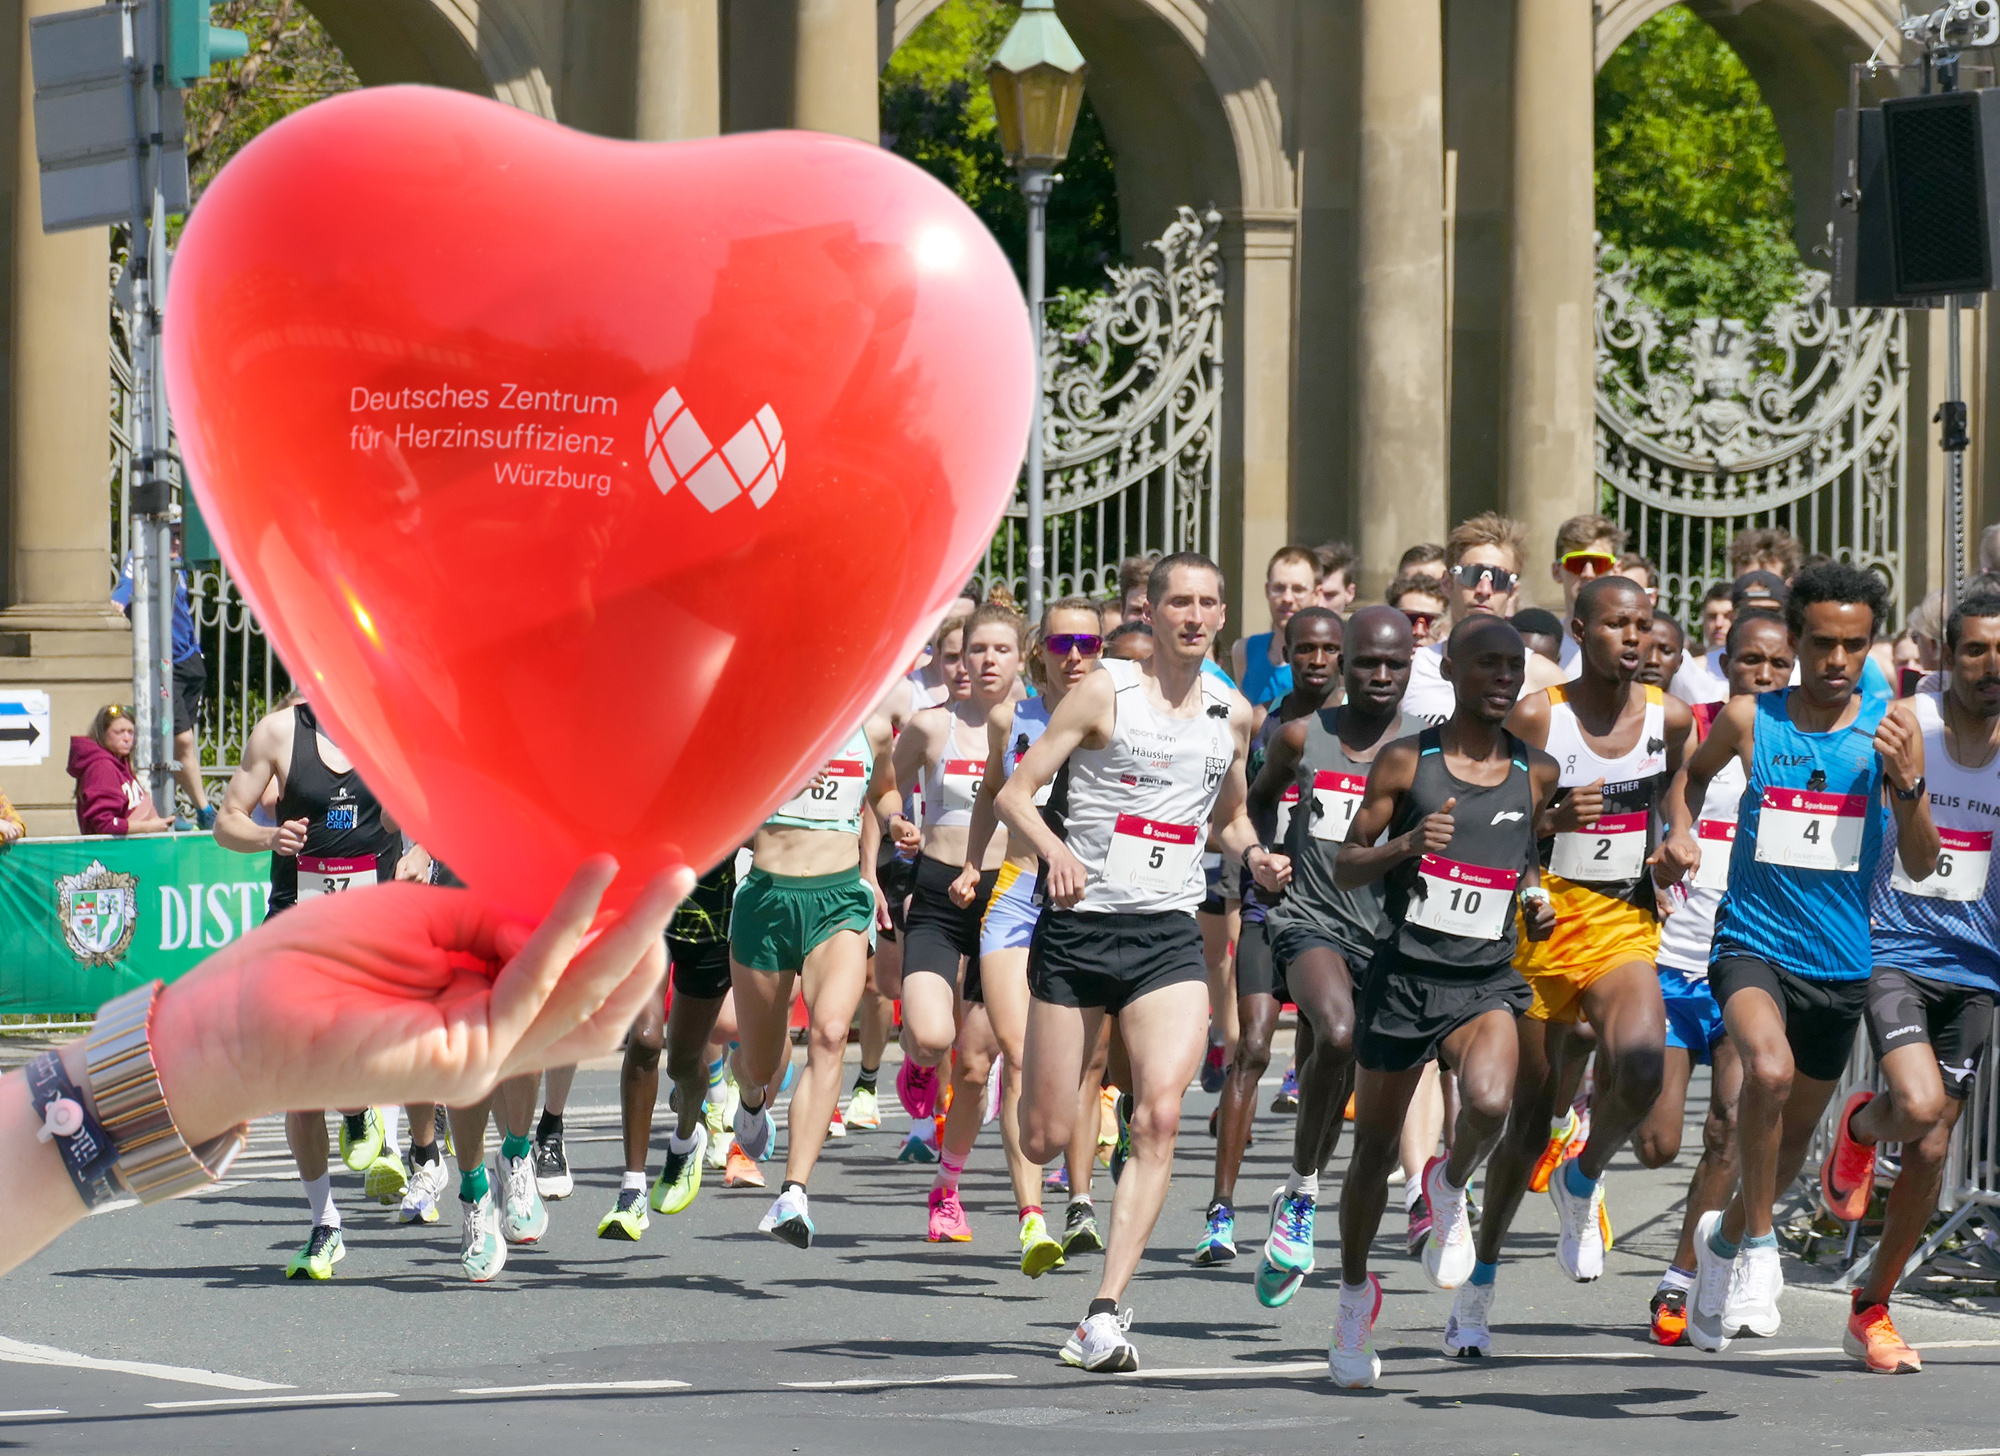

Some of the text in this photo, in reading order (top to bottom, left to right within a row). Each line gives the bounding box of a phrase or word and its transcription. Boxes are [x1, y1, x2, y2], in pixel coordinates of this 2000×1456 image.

[350, 383, 618, 416] Deutsches Zentrum
[350, 422, 614, 456] für Herzinsuffizienz
[494, 462, 611, 496] Würzburg
[1131, 746, 1174, 761] Häussler
[1206, 758, 1226, 768] SSV
[811, 780, 839, 801] 62
[971, 780, 982, 799] 9
[1600, 781, 1639, 796] GETHER
[1343, 798, 1354, 820] 1
[1804, 801, 1838, 812] Sparkasse
[1928, 793, 1960, 808] ELIS
[326, 821, 352, 829] CREW
[327, 810, 353, 821] RUN
[1154, 830, 1181, 840] Sparkasse
[1803, 820, 1820, 844] 4
[1148, 846, 1165, 869] 5
[1593, 838, 1611, 860] 2
[1936, 854, 1953, 877] 6
[1461, 872, 1492, 884] Sparkasse
[1450, 887, 1482, 914] 10
[158, 881, 272, 951] DIST
